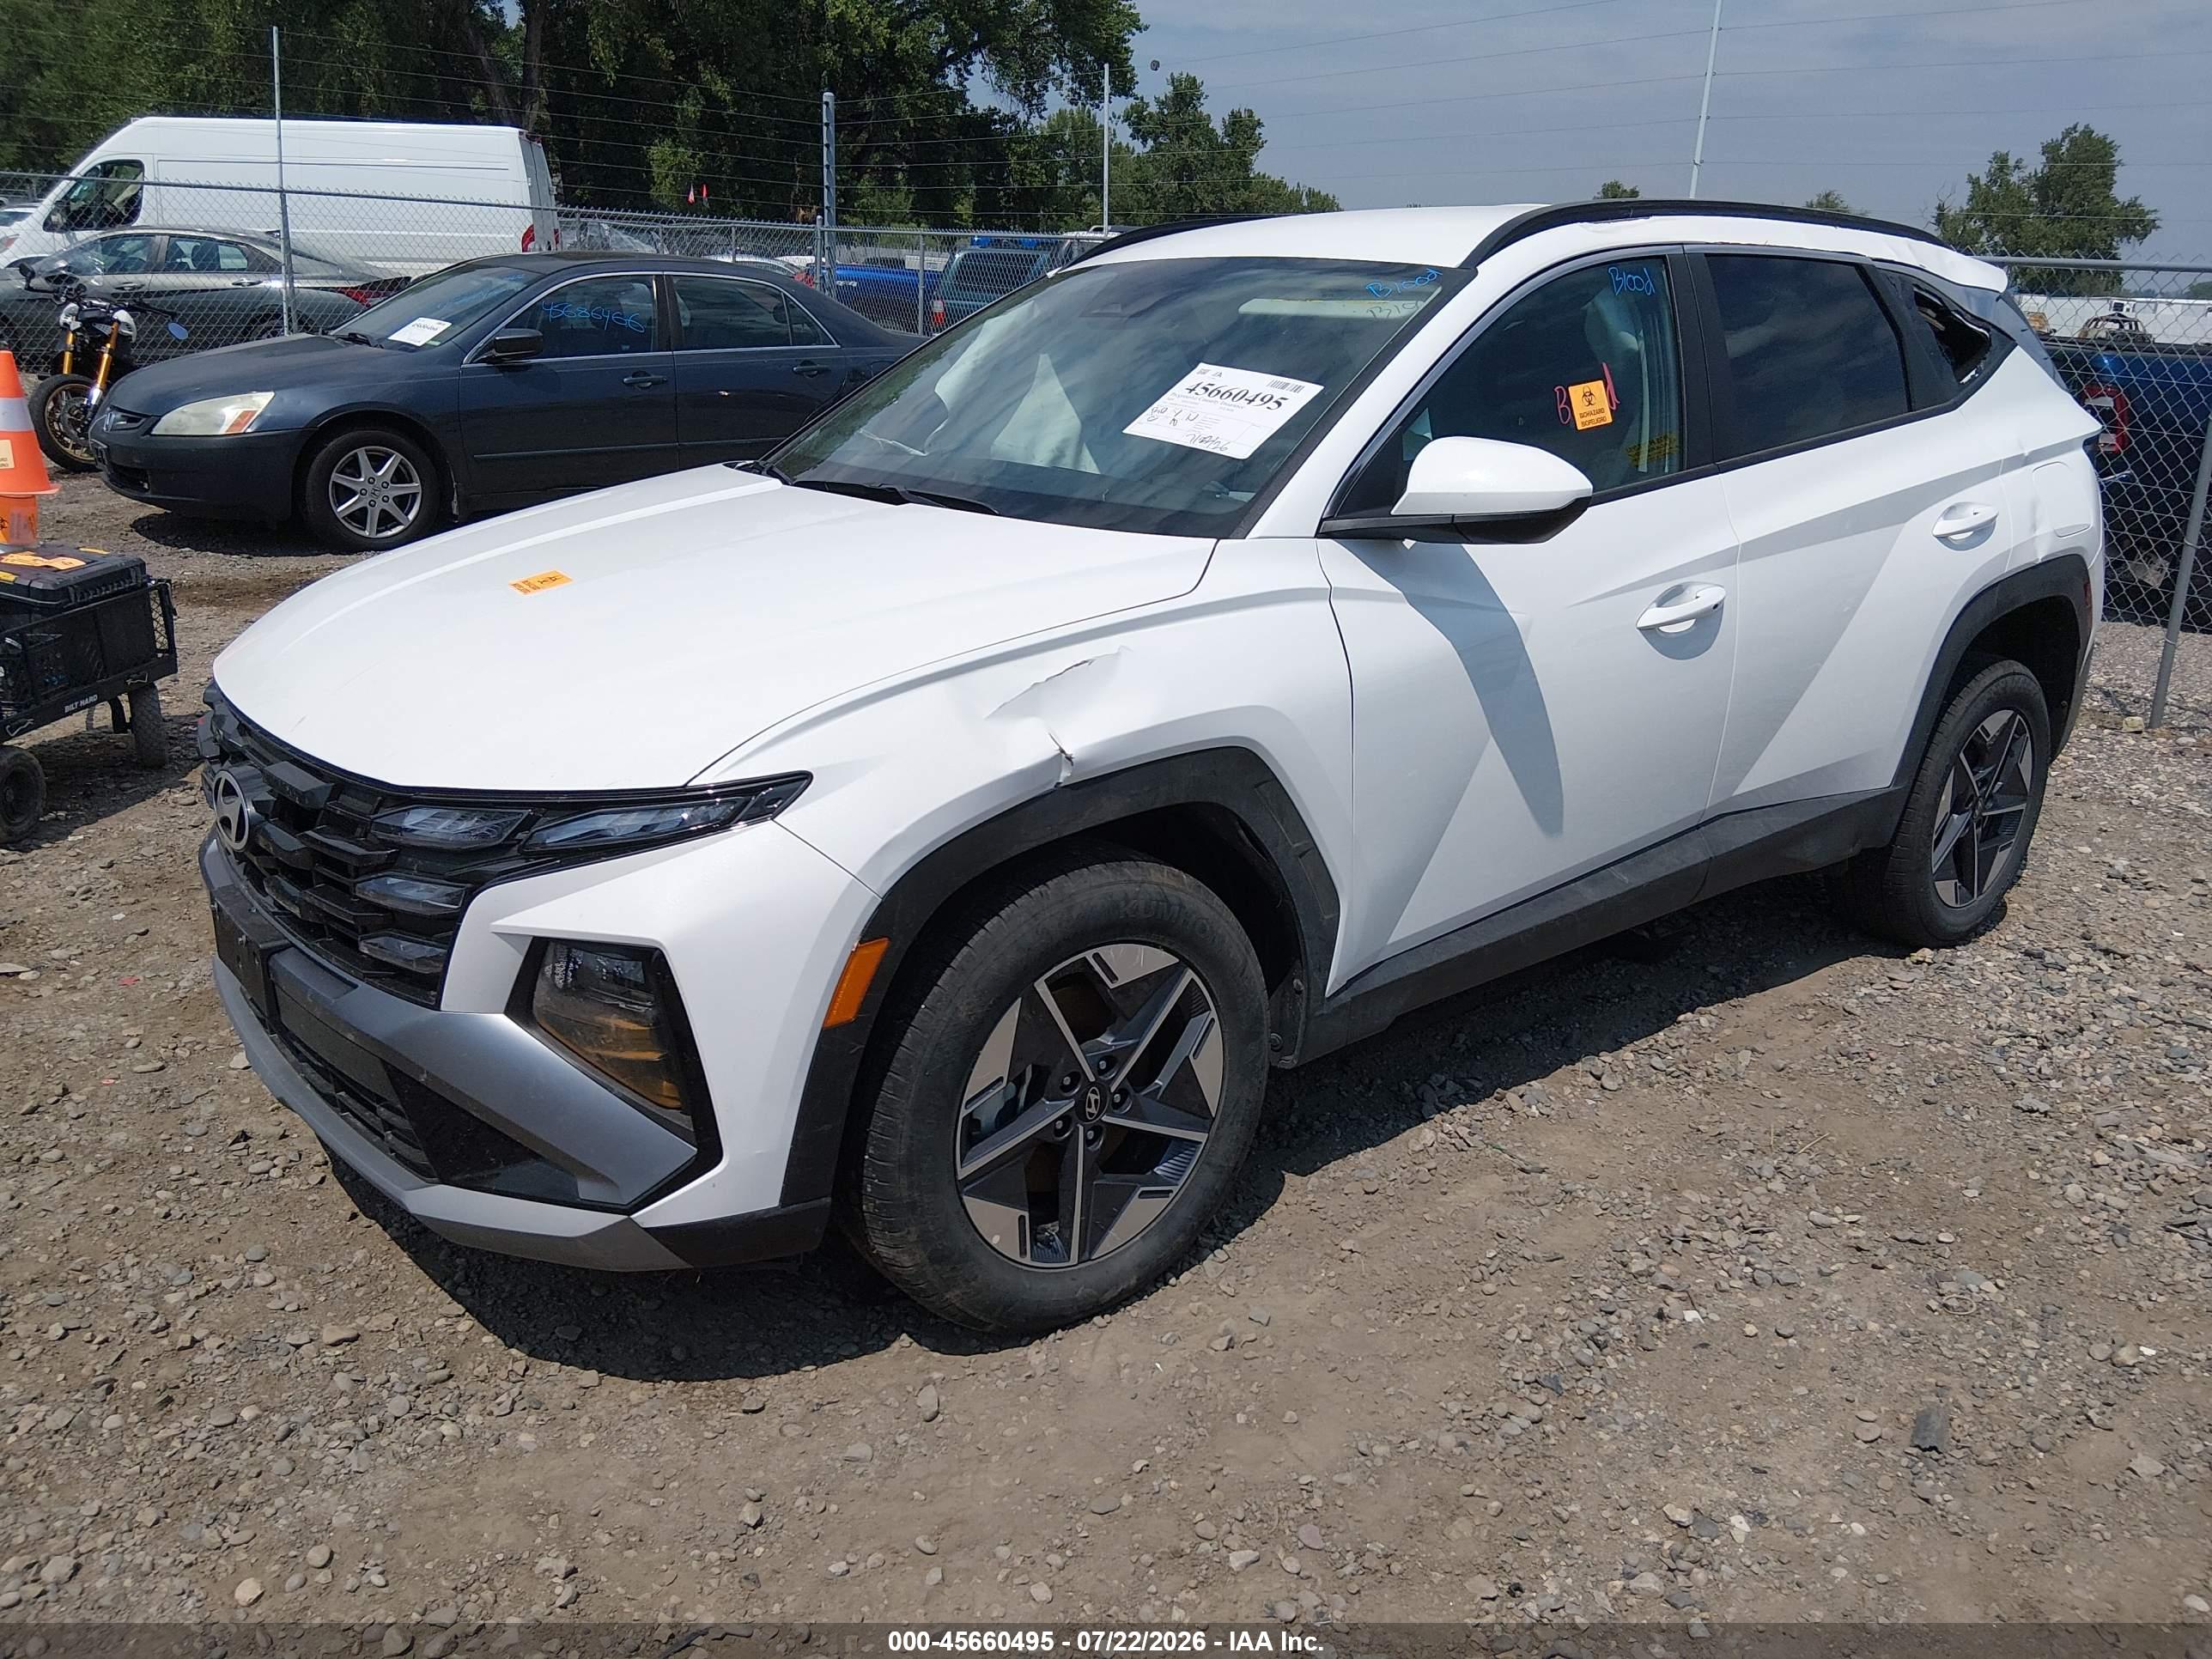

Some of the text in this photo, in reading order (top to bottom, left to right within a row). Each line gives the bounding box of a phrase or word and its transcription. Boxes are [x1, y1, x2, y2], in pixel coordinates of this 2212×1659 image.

[1365, 268, 1443, 298] Blood
[1608, 266, 1656, 296] Blood
[542, 301, 646, 333] 45686466
[1184, 380, 1290, 411] 45660495
[1578, 407, 1605, 419] BIOHAZARD
[1580, 416, 1607, 428] BIOPELIGRO
